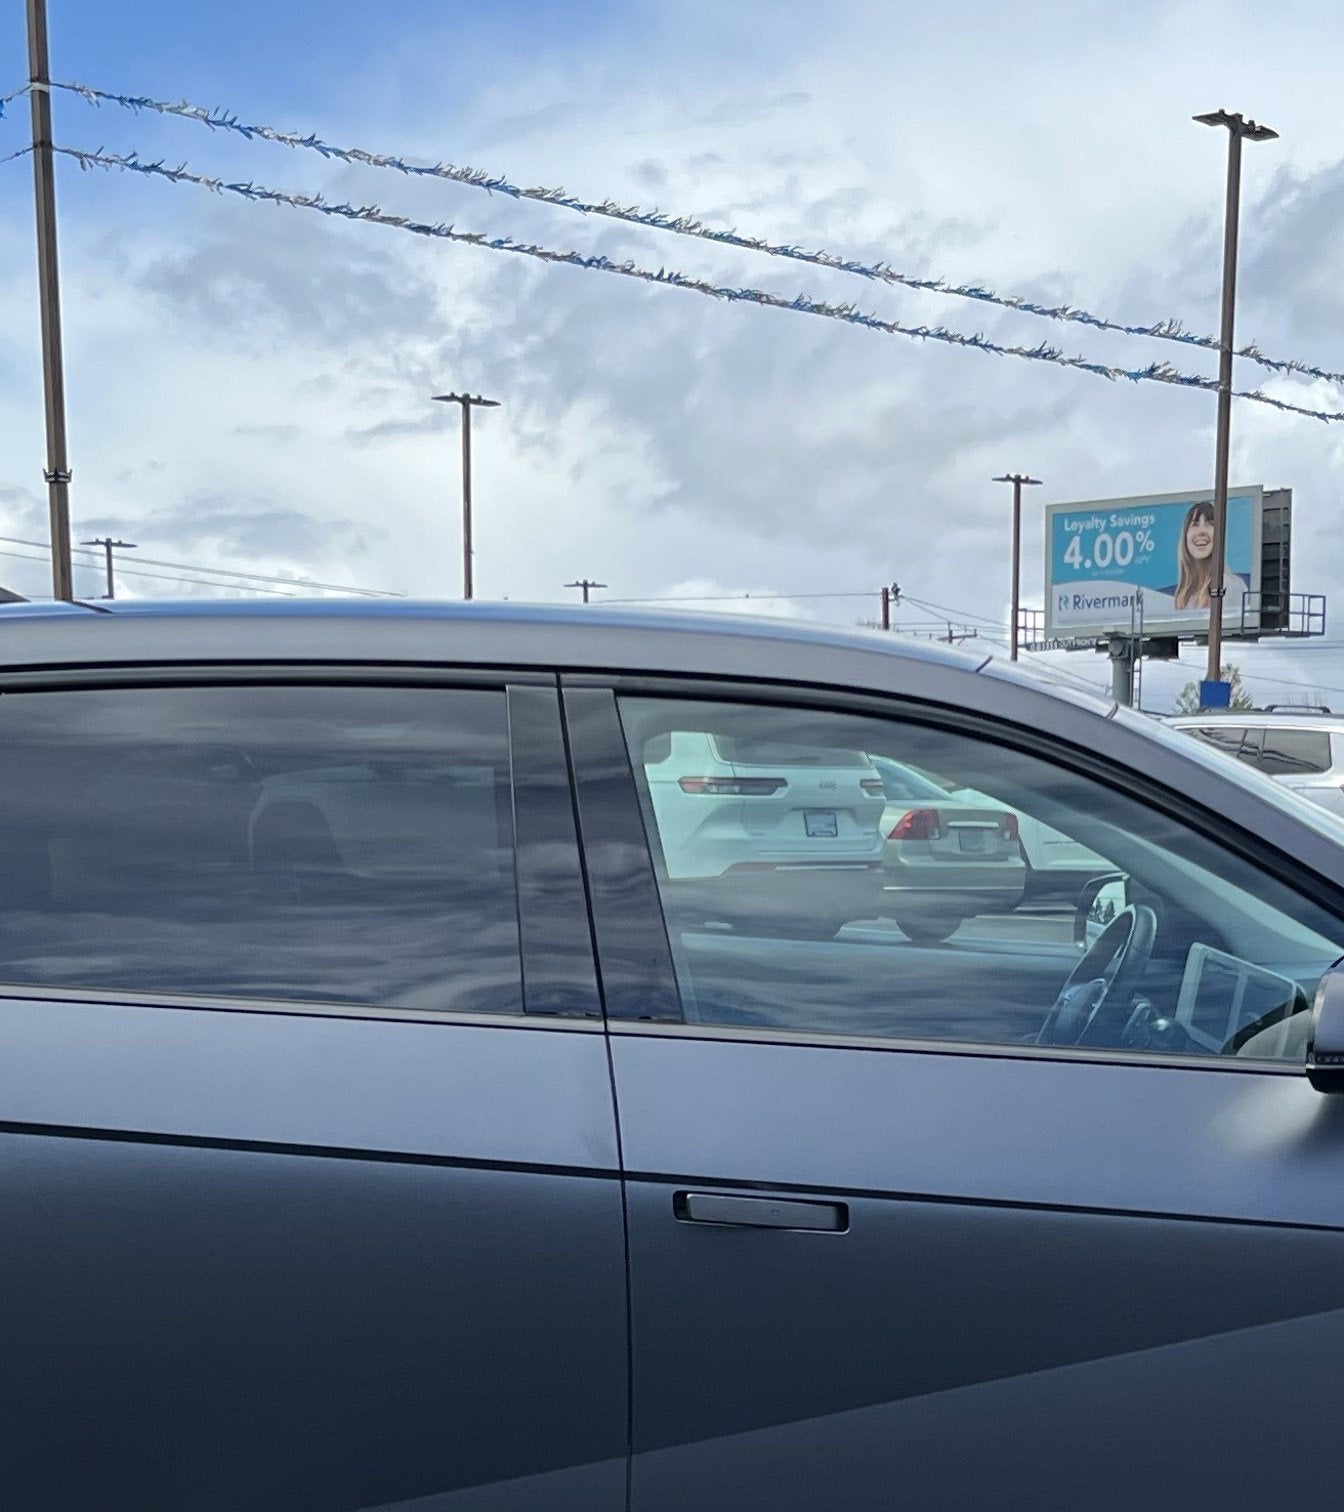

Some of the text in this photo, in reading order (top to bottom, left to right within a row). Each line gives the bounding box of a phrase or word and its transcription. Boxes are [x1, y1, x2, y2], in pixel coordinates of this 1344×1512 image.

[1064, 514, 1155, 534] Loyalty Savings
[1072, 594, 1142, 610] Rivermark
